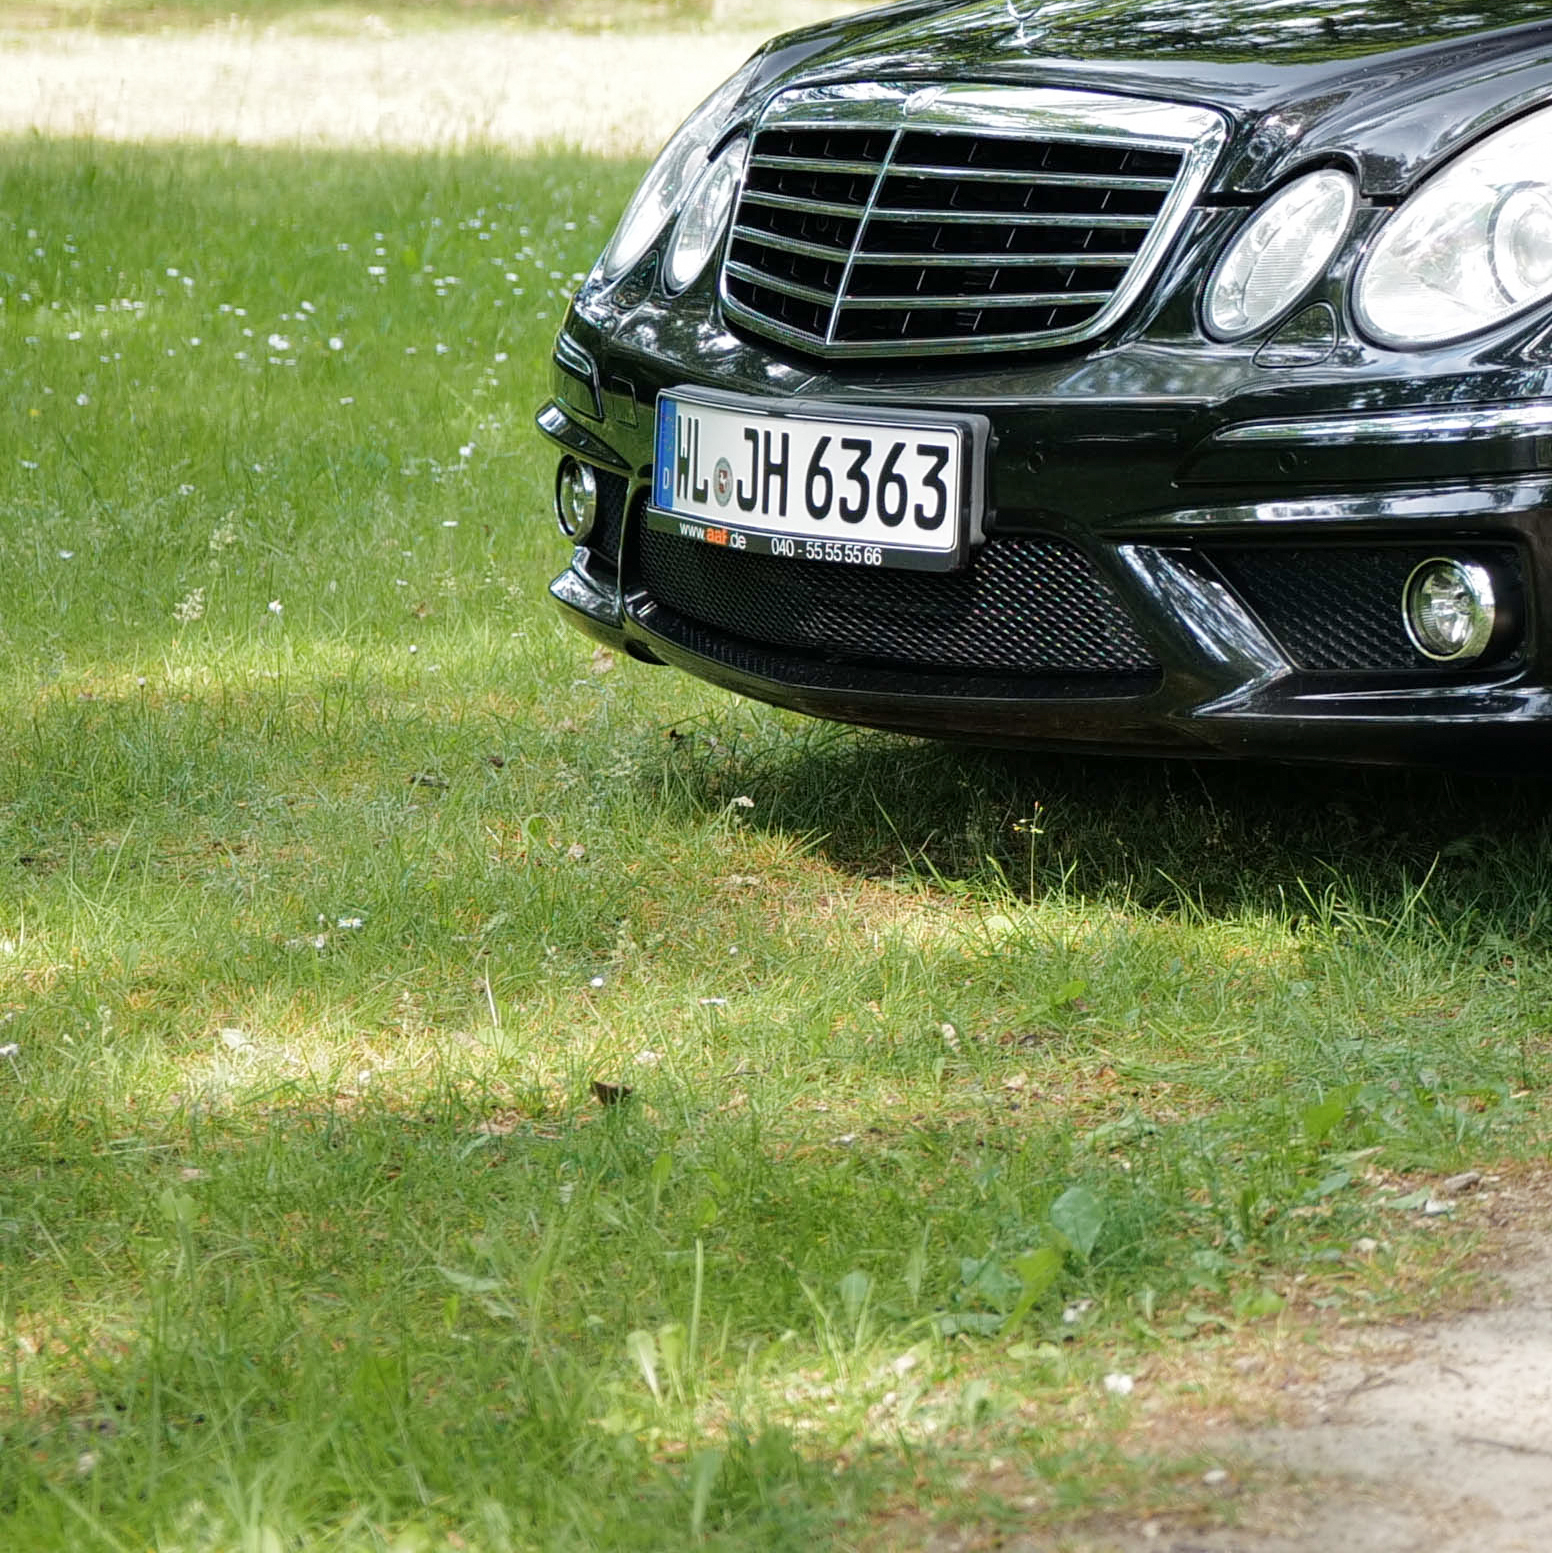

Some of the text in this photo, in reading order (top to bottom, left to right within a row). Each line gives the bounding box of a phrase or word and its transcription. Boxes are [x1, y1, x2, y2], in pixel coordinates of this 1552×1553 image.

[663, 467, 670, 490] D
[675, 415, 950, 531] WL JH 6363
[771, 536, 795, 557] 040
[806, 540, 823, 560] 55
[825, 542, 842, 561] 55
[844, 544, 862, 564] 55
[864, 547, 882, 566] 66
